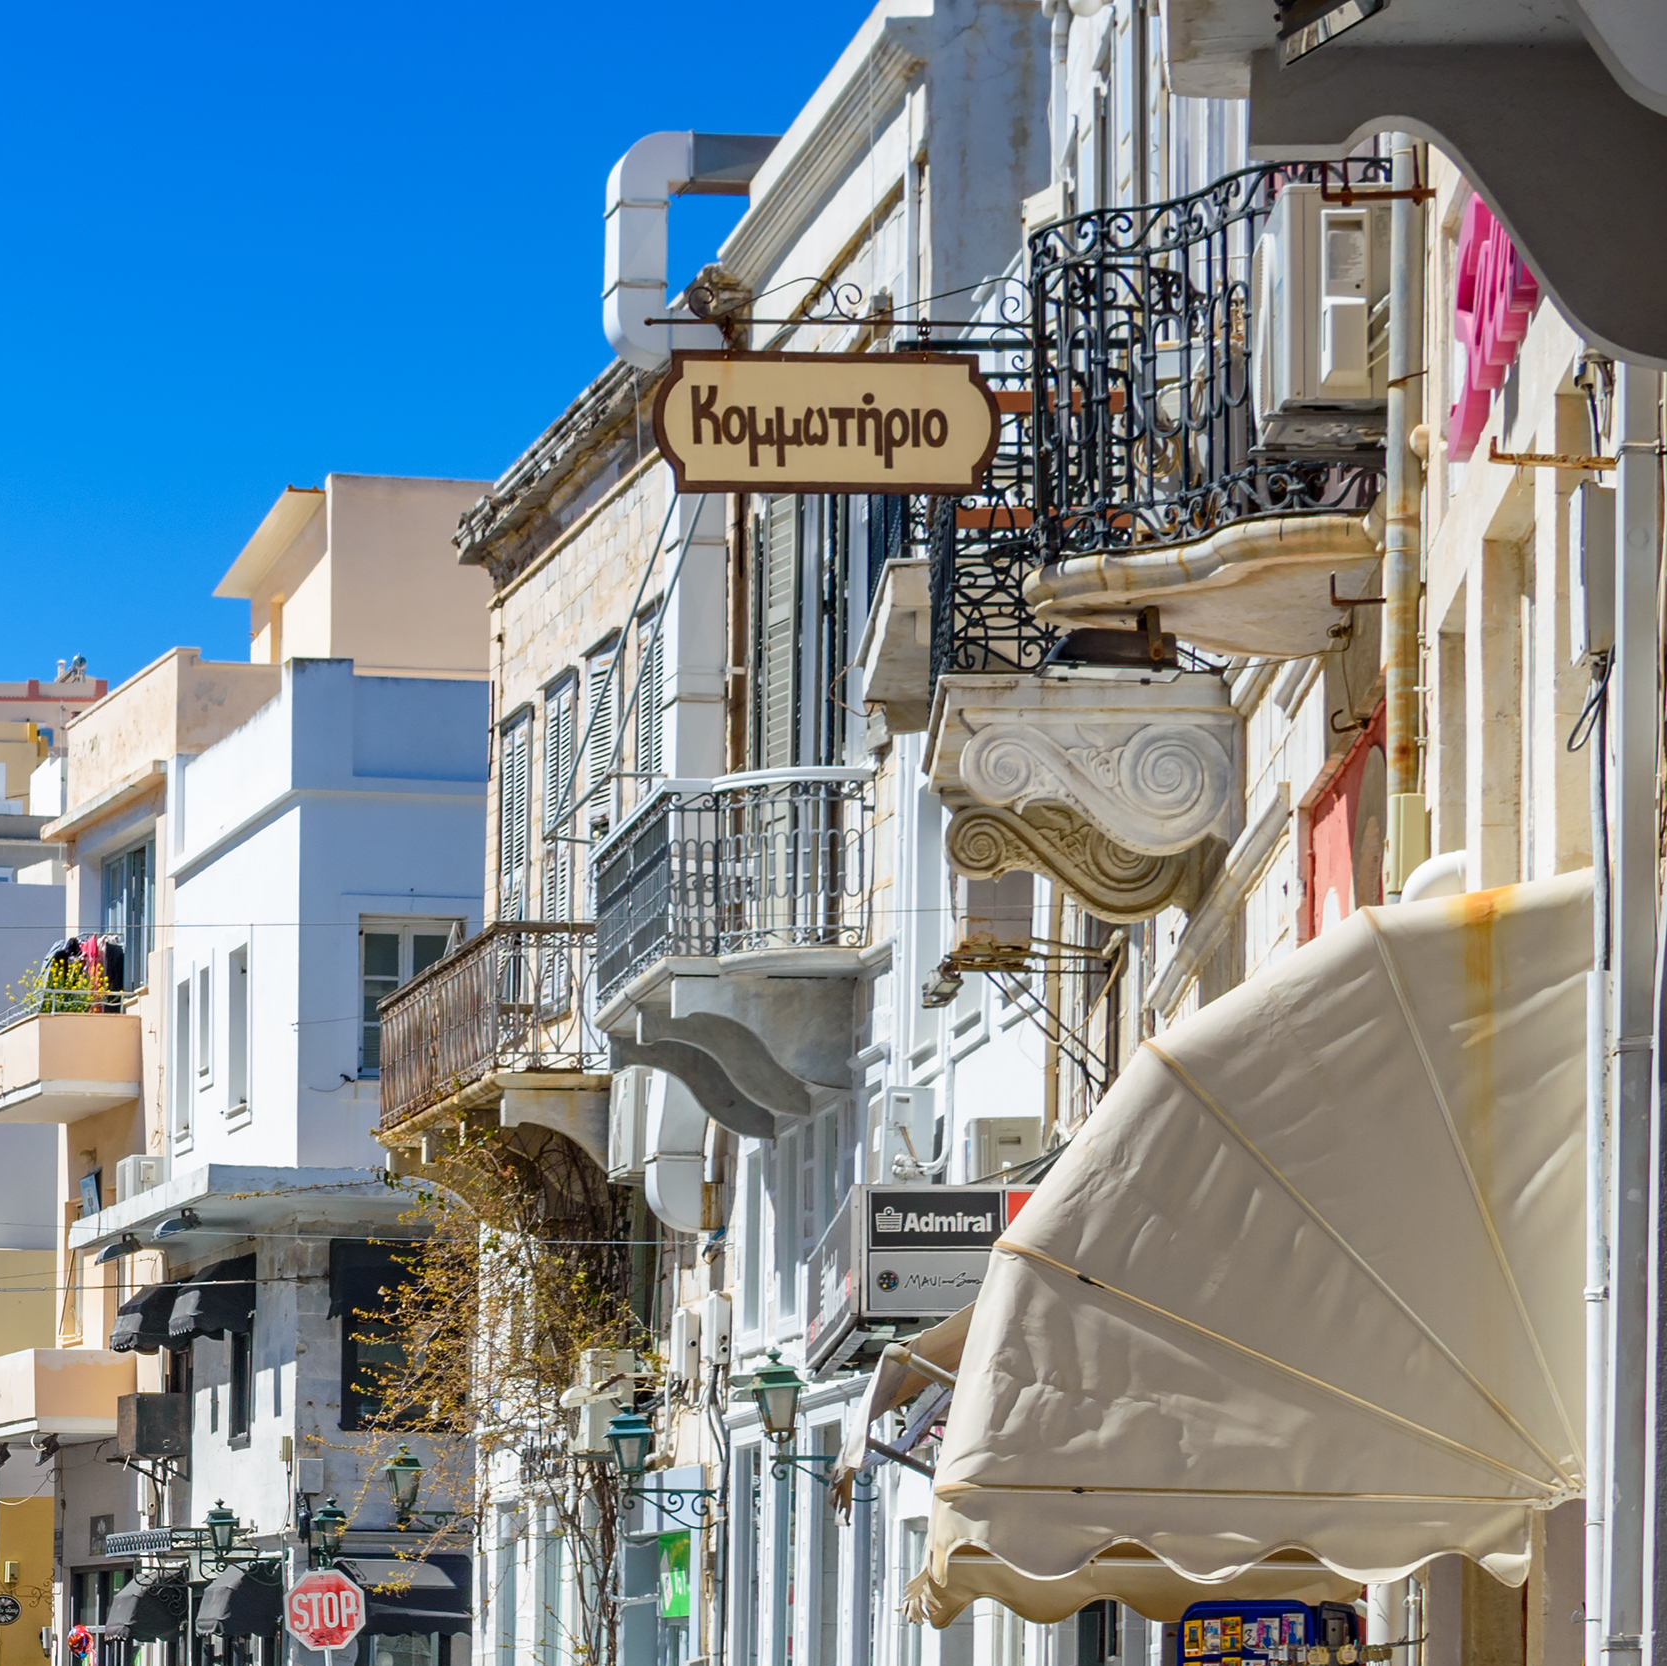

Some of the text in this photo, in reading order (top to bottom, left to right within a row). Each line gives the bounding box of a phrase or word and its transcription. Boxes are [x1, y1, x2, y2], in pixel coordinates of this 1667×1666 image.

[691, 385, 948, 469] Κομμωτήριο
[903, 1212, 993, 1232] Admiral
[904, 1274, 941, 1289] MAUI
[292, 1590, 357, 1630] STOP
